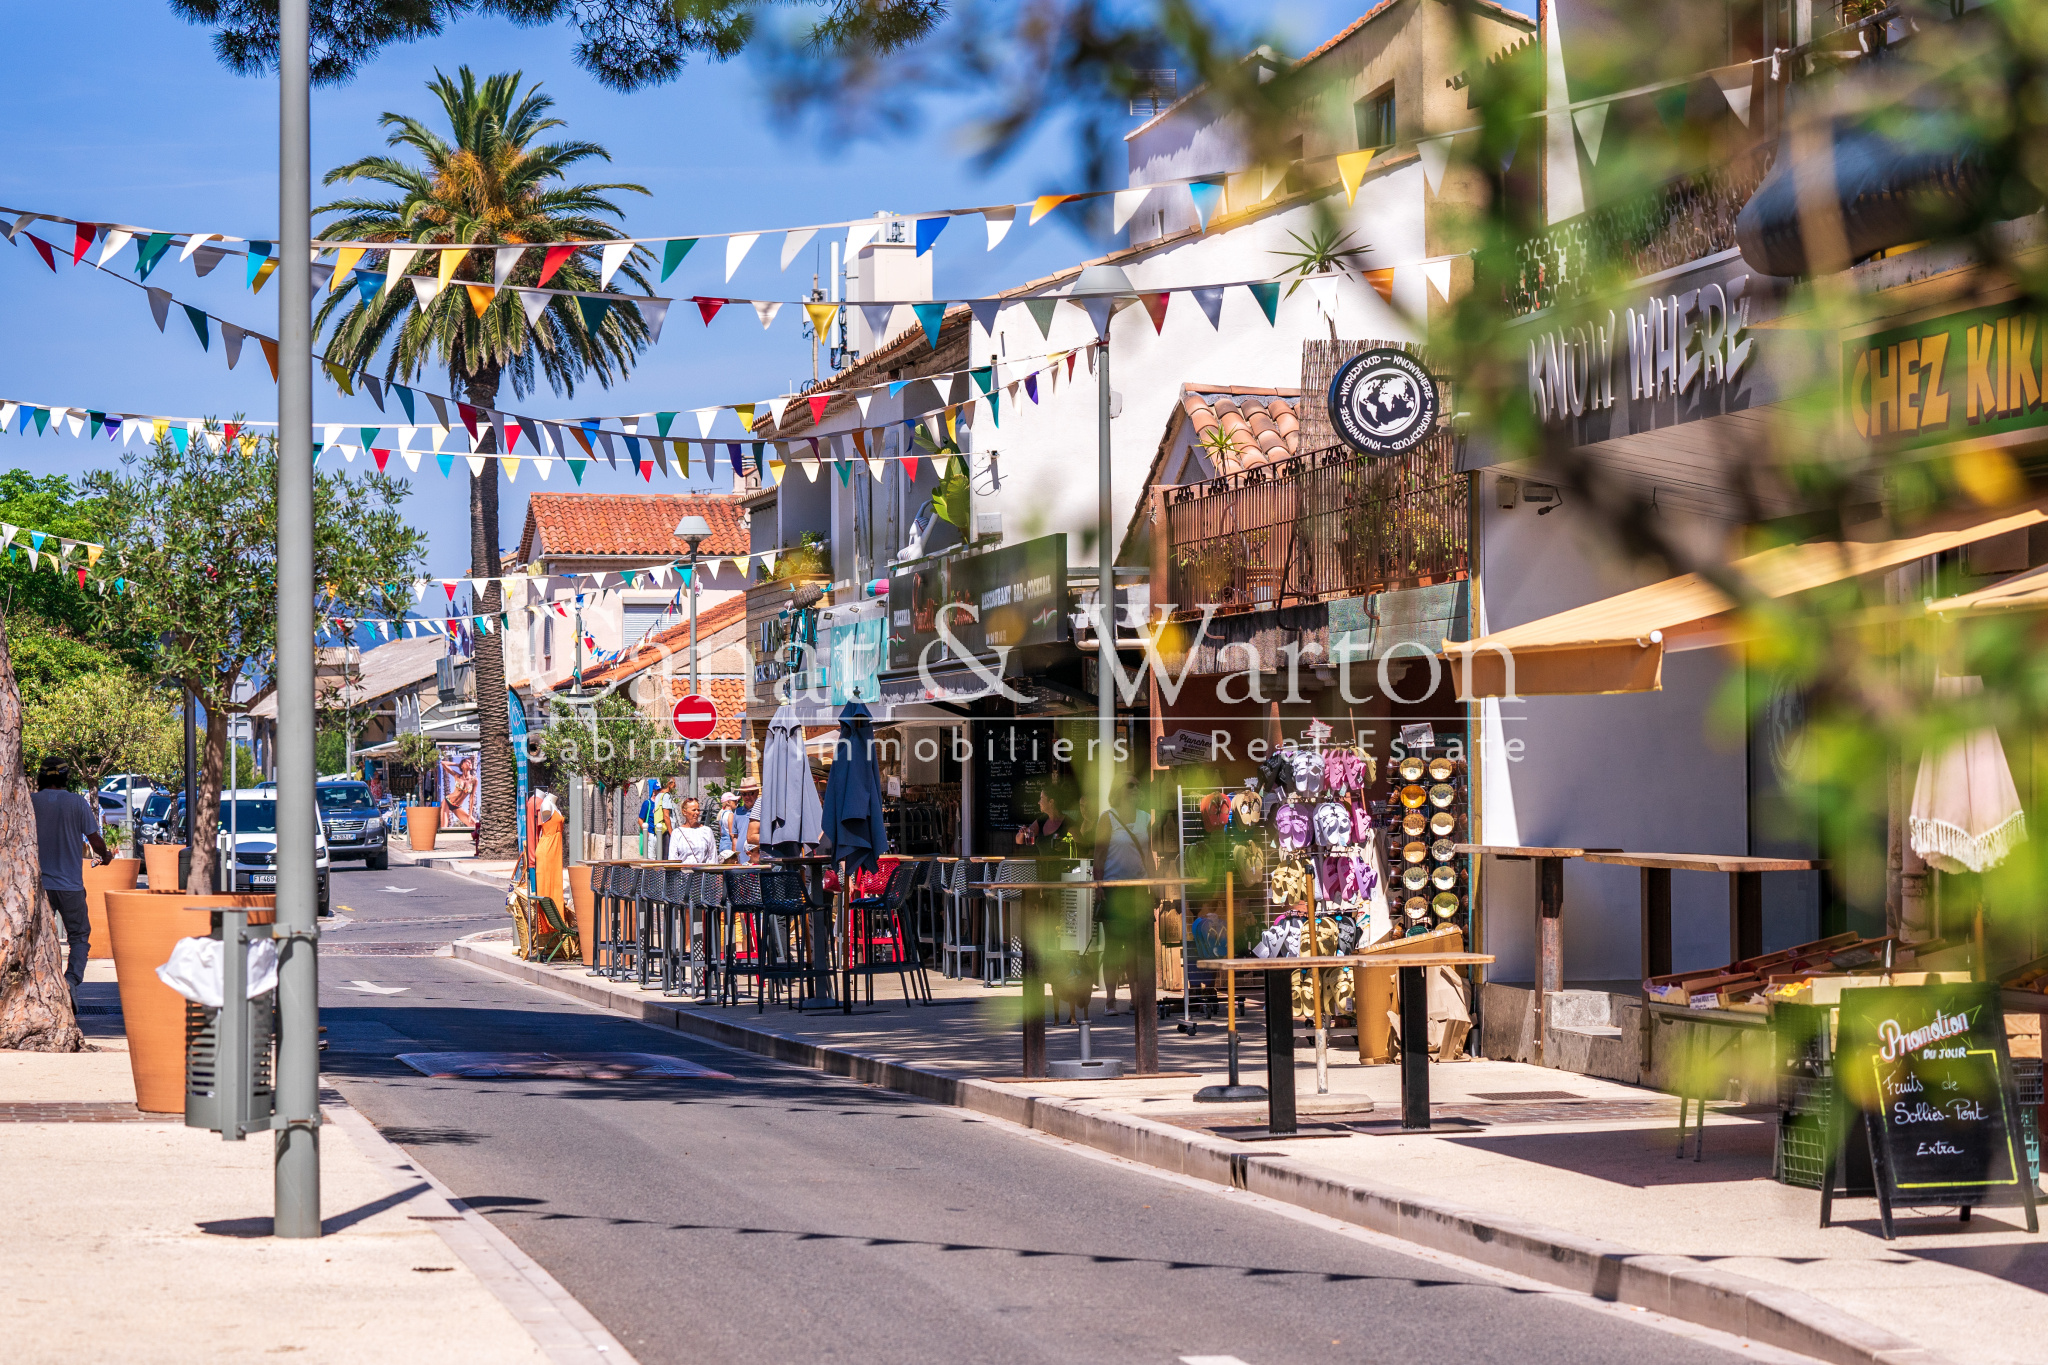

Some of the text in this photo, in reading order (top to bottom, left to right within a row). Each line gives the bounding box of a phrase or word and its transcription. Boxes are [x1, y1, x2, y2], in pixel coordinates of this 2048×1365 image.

[1528, 273, 1754, 424] KNOW WHERE
[1340, 355, 1382, 396] WORLDFOOD
[1393, 354, 1434, 400] KNOWWHERE
[1851, 331, 1950, 442] CHEZ
[1340, 406, 1382, 451] KNOWWHERE
[1391, 410, 1434, 451] WORLDFOOD
[1877, 1009, 1970, 1063] Promotion
[1923, 1047, 1967, 1060] DU JOUR
[1882, 1069, 1960, 1096] Fruits de
[1916, 1140, 1965, 1156] Extra
